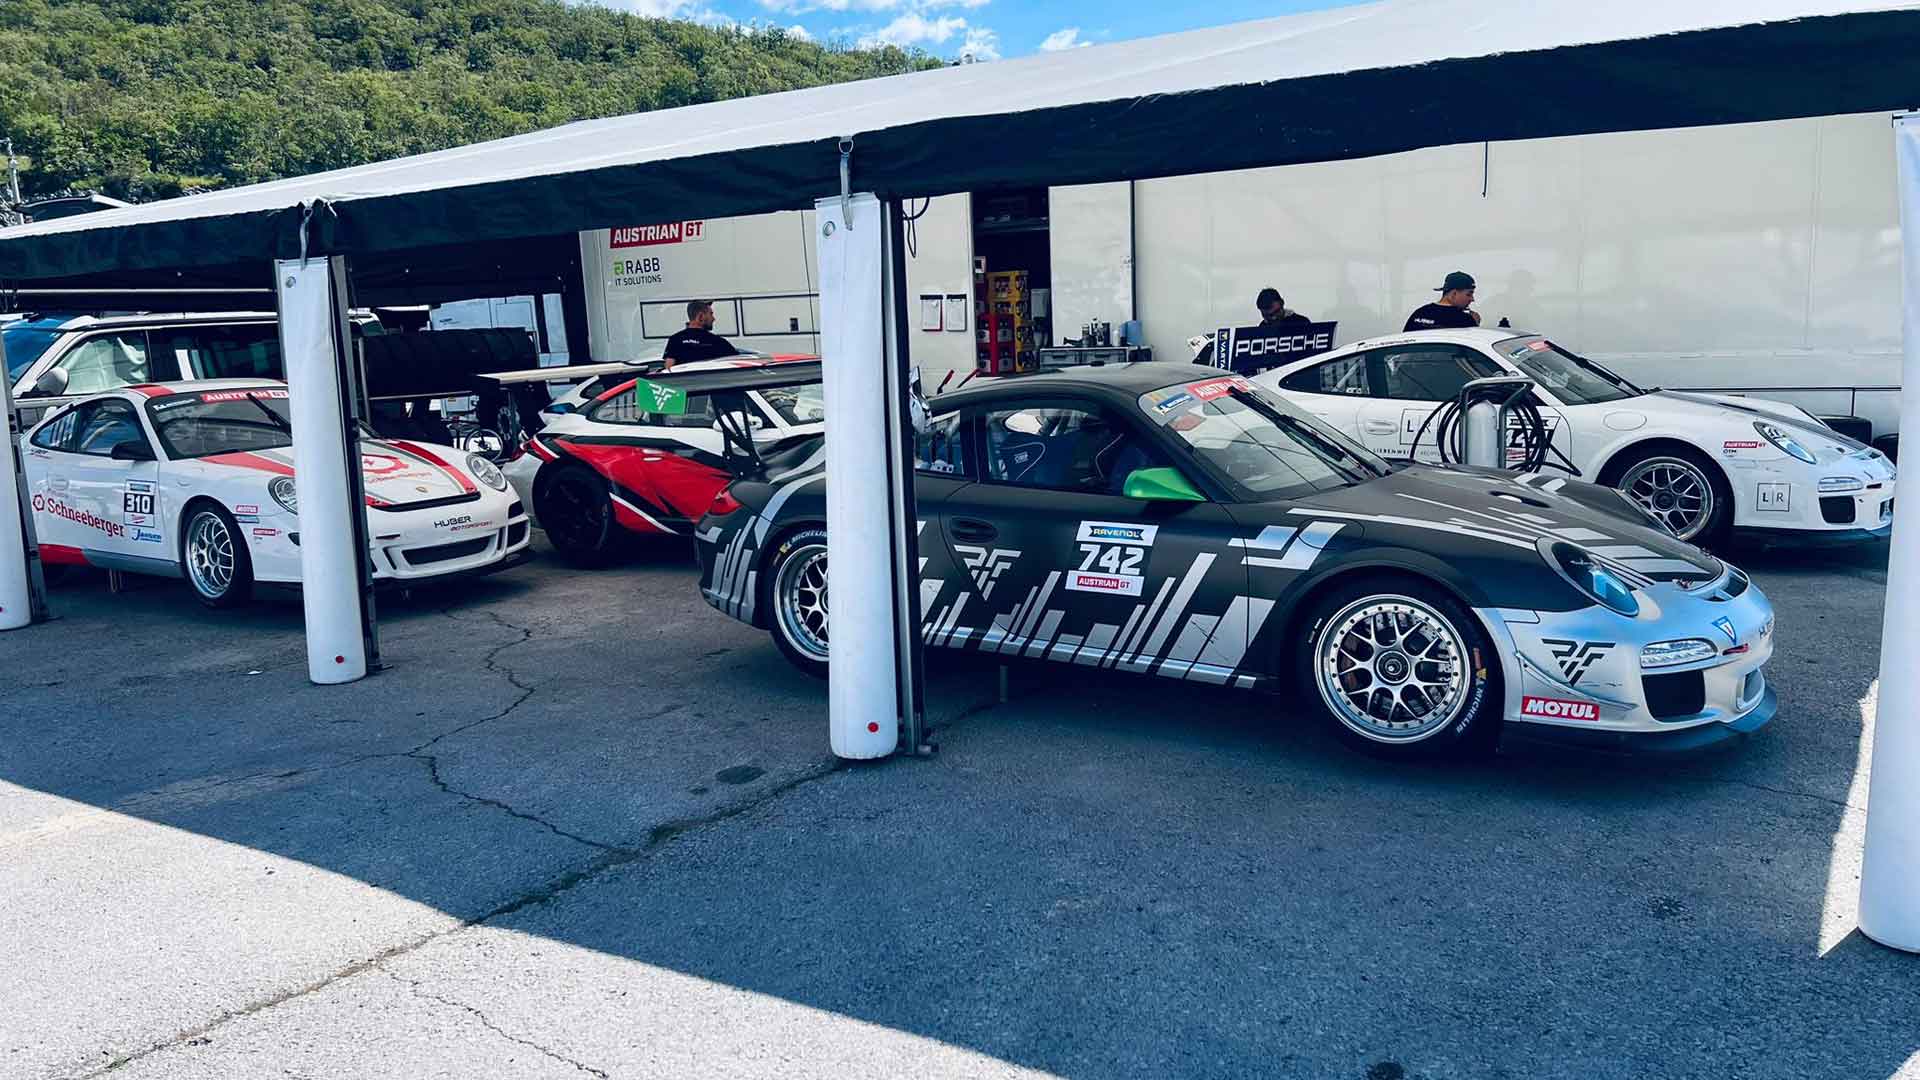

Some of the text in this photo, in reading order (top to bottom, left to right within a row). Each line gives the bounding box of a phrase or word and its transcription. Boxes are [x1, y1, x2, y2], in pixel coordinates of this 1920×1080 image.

[613, 220, 703, 244] AUSTRIAN GT
[625, 257, 660, 274] RABB
[615, 274, 662, 286] IT SOLUTIONS
[1234, 333, 1329, 357] PORSCHE
[126, 494, 151, 513] 310
[47, 497, 125, 537] Schneeberger
[434, 515, 473, 528] HUBER
[1093, 528, 1140, 538] RAVENOL
[1078, 543, 1145, 576] 742
[1078, 577, 1131, 589] AUSTRIAN GT
[1455, 687, 1484, 734] MICHELIN
[1525, 699, 1596, 719] MOTUL
